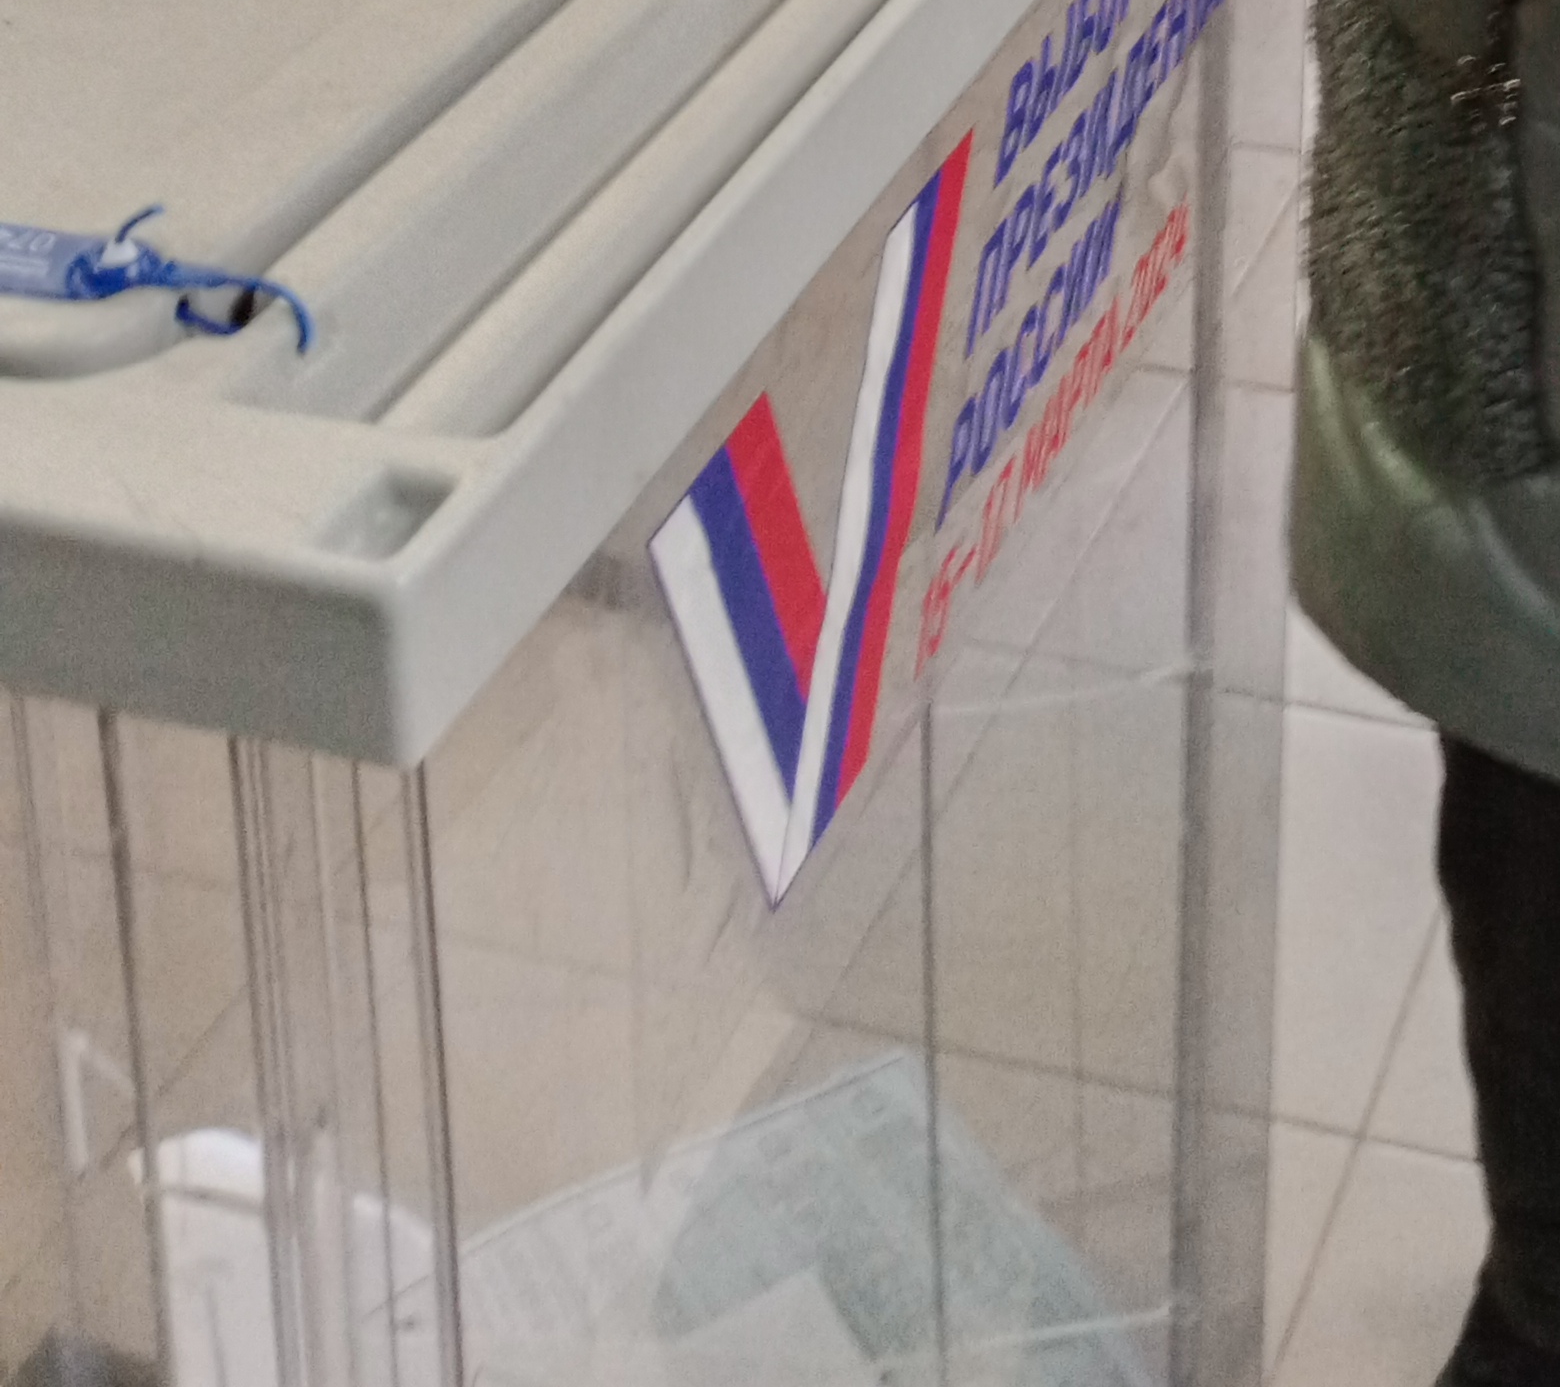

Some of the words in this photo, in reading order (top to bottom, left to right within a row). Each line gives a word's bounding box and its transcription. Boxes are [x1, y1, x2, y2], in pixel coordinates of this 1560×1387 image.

[935, 190, 1121, 531] РОССИИ
[1013, 293, 1120, 524] МАРТА
[1119, 193, 1190, 353] 2024
